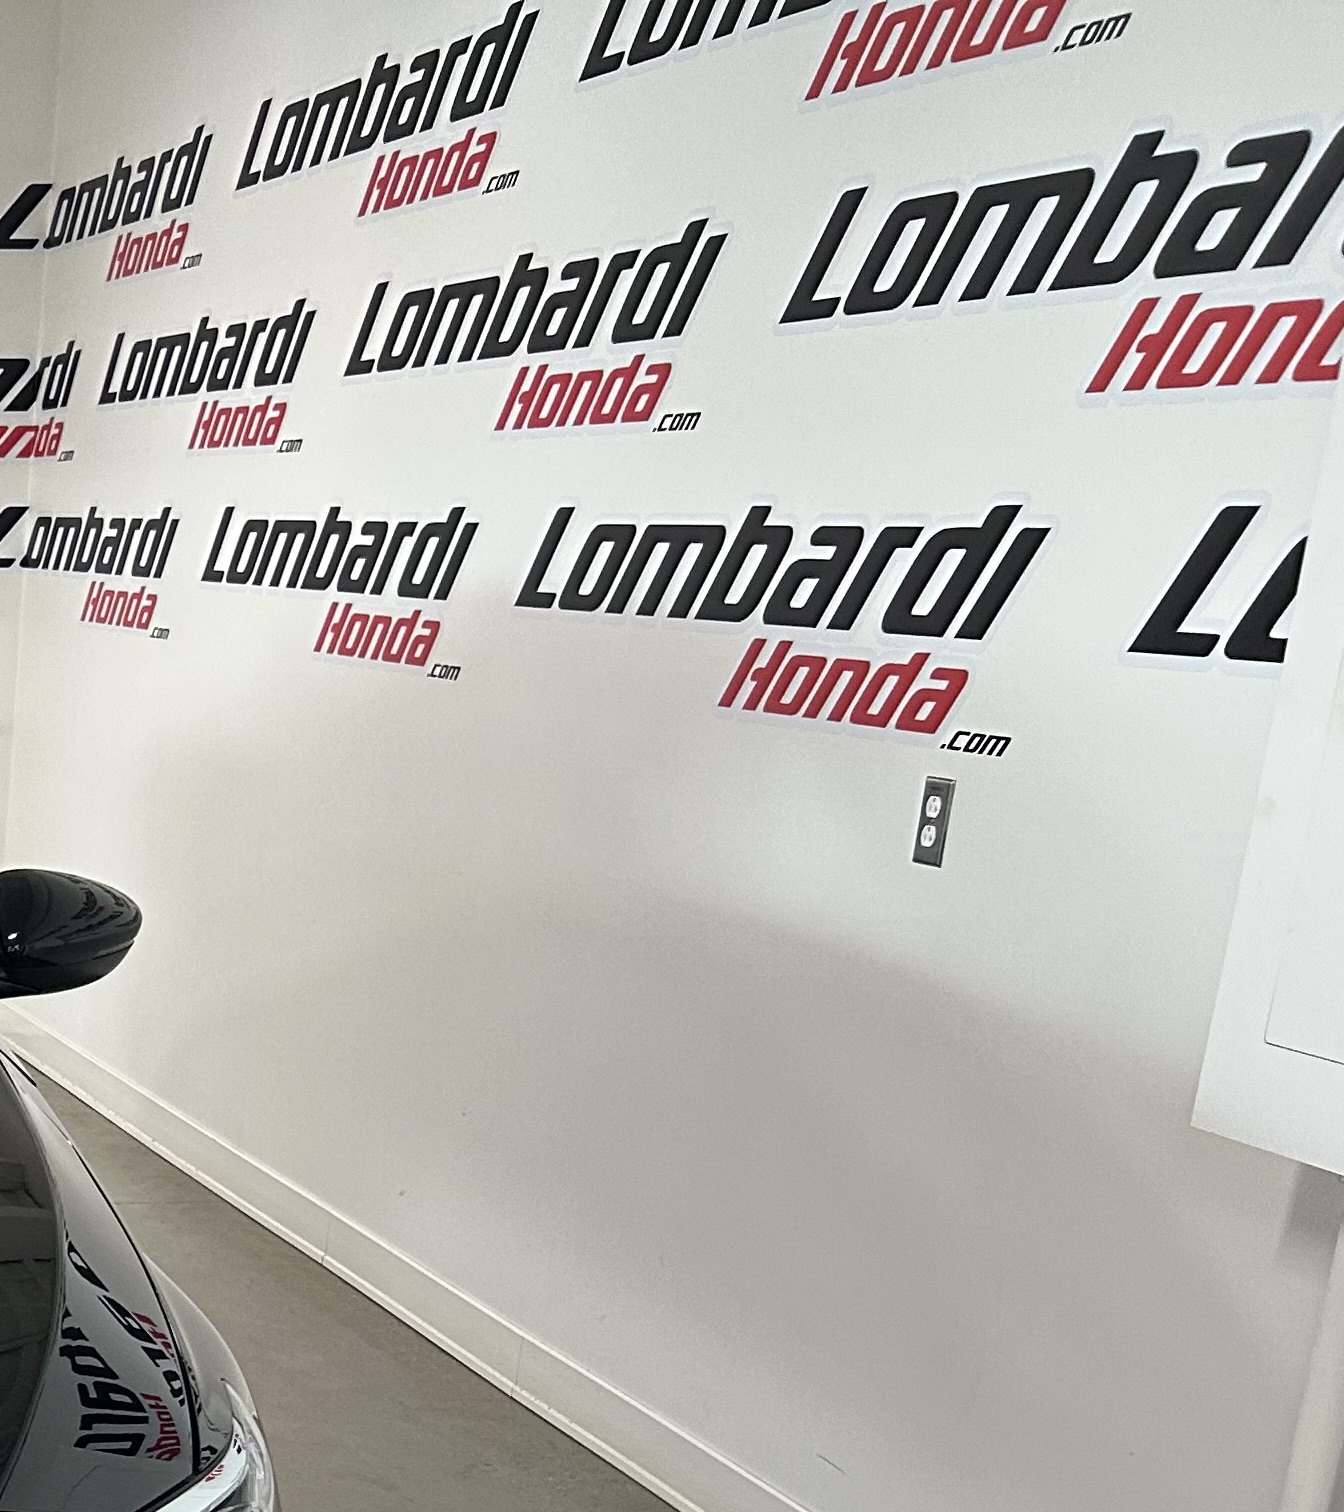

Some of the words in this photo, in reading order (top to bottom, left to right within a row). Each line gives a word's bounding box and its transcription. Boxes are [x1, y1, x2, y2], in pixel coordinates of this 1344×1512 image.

[1053, 13, 1132, 53] .com
[235, 0, 540, 191] Lombardi
[357, 127, 497, 217] Honda
[482, 169, 520, 195] .com
[106, 219, 190, 281] Honda
[779, 125, 1344, 324] Lombar
[343, 218, 728, 376] Lombardi
[97, 299, 316, 405] Lombardi
[495, 355, 672, 431] Honda
[652, 411, 701, 432] .com
[188, 396, 287, 449] Honda
[201, 506, 479, 600] Lombardi
[515, 504, 1050, 640] Lombardi
[80, 581, 157, 630] Honda
[313, 602, 439, 667] Honda
[427, 662, 460, 681] .com
[718, 637, 969, 735] Honda
[940, 729, 1011, 757] .com
